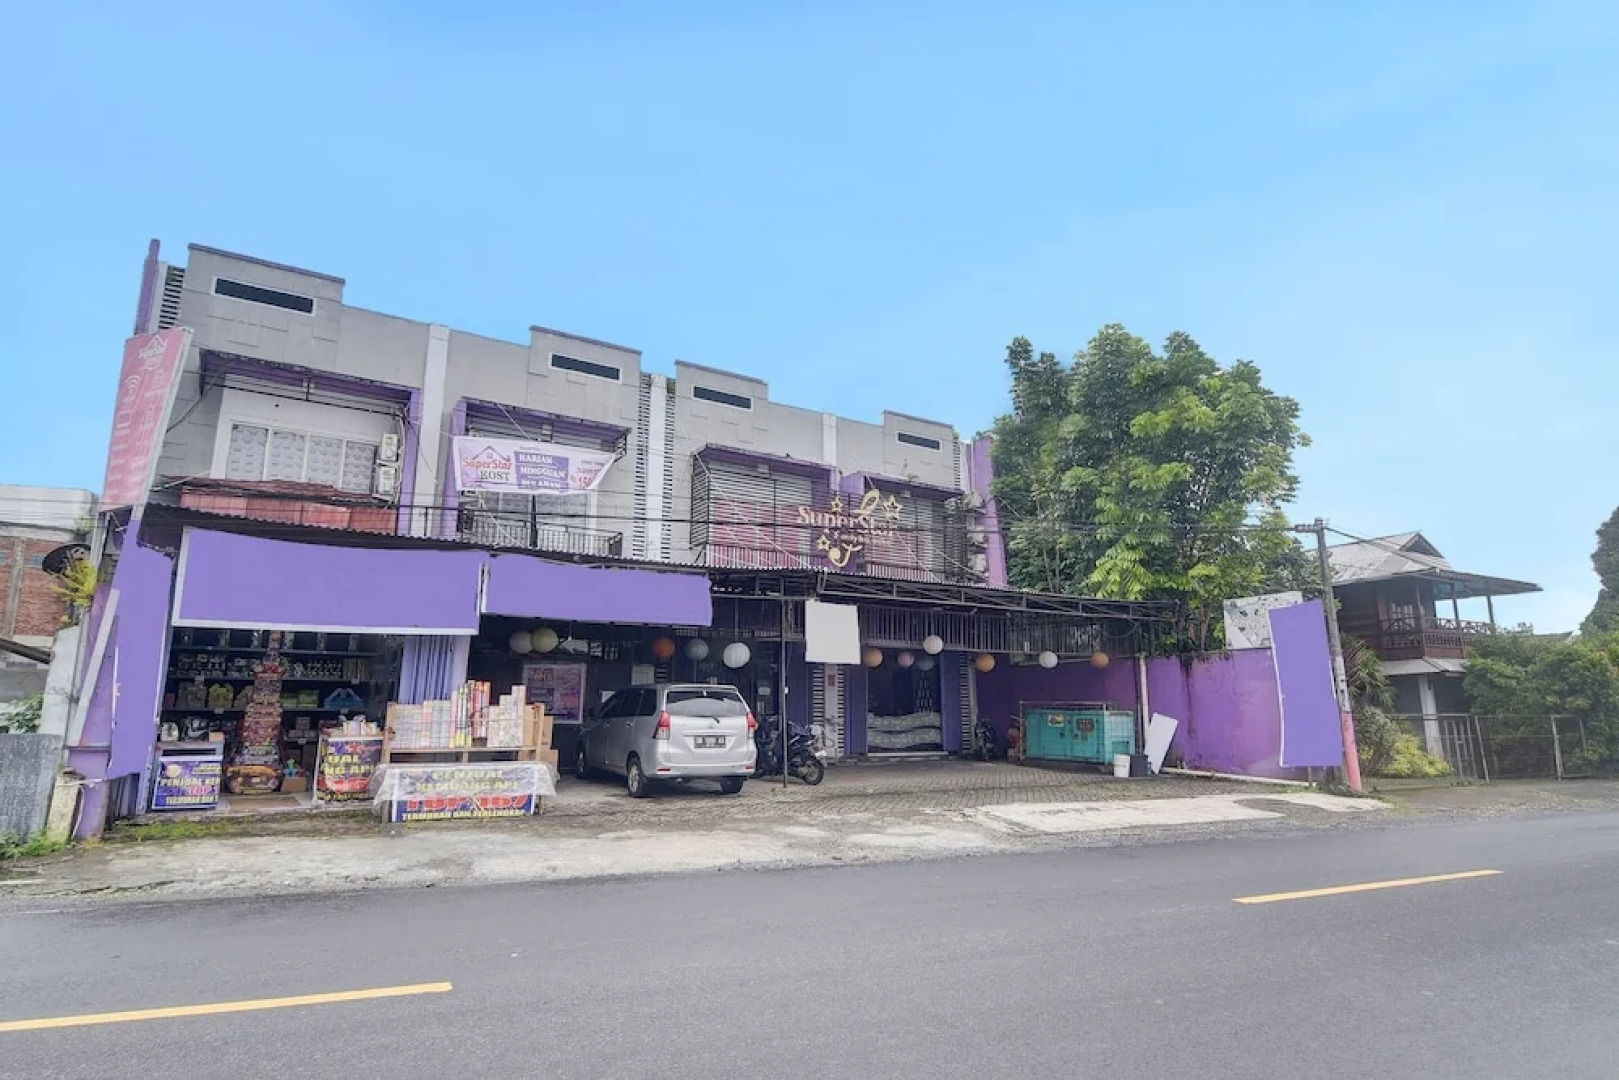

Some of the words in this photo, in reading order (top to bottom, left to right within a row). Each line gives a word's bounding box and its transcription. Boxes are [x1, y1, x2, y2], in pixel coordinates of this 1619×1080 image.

[463, 457, 512, 470] SuperStar
[519, 453, 553, 464] HARIAN
[479, 470, 510, 481] KOST
[797, 506, 898, 537] SuperStar
[432, 769, 503, 780] PENJUAL
[405, 794, 468, 811] TOP
[477, 792, 529, 810] 167
